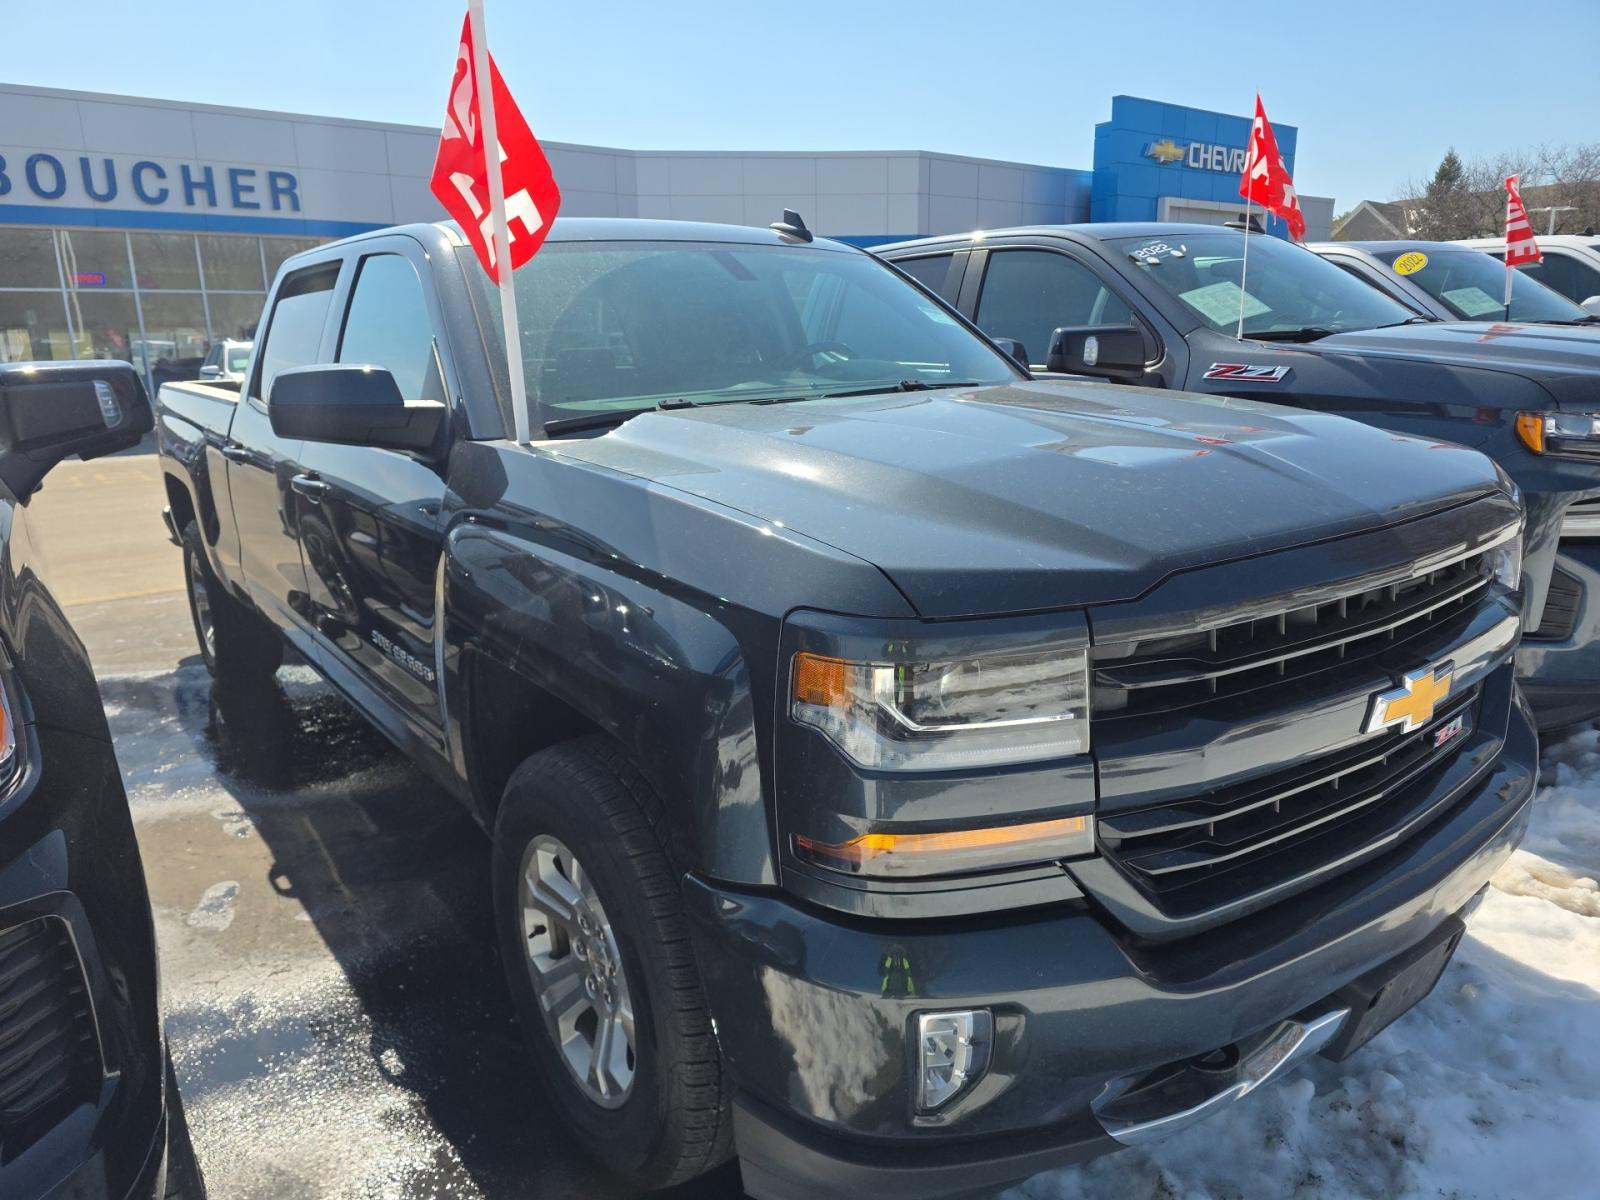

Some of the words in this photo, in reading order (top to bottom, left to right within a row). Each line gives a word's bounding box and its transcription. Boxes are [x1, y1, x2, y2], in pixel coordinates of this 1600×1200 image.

[1188, 142, 1245, 175] CHEVR
[1135, 243, 1173, 259] 2022
[1202, 362, 1292, 382] Z71
